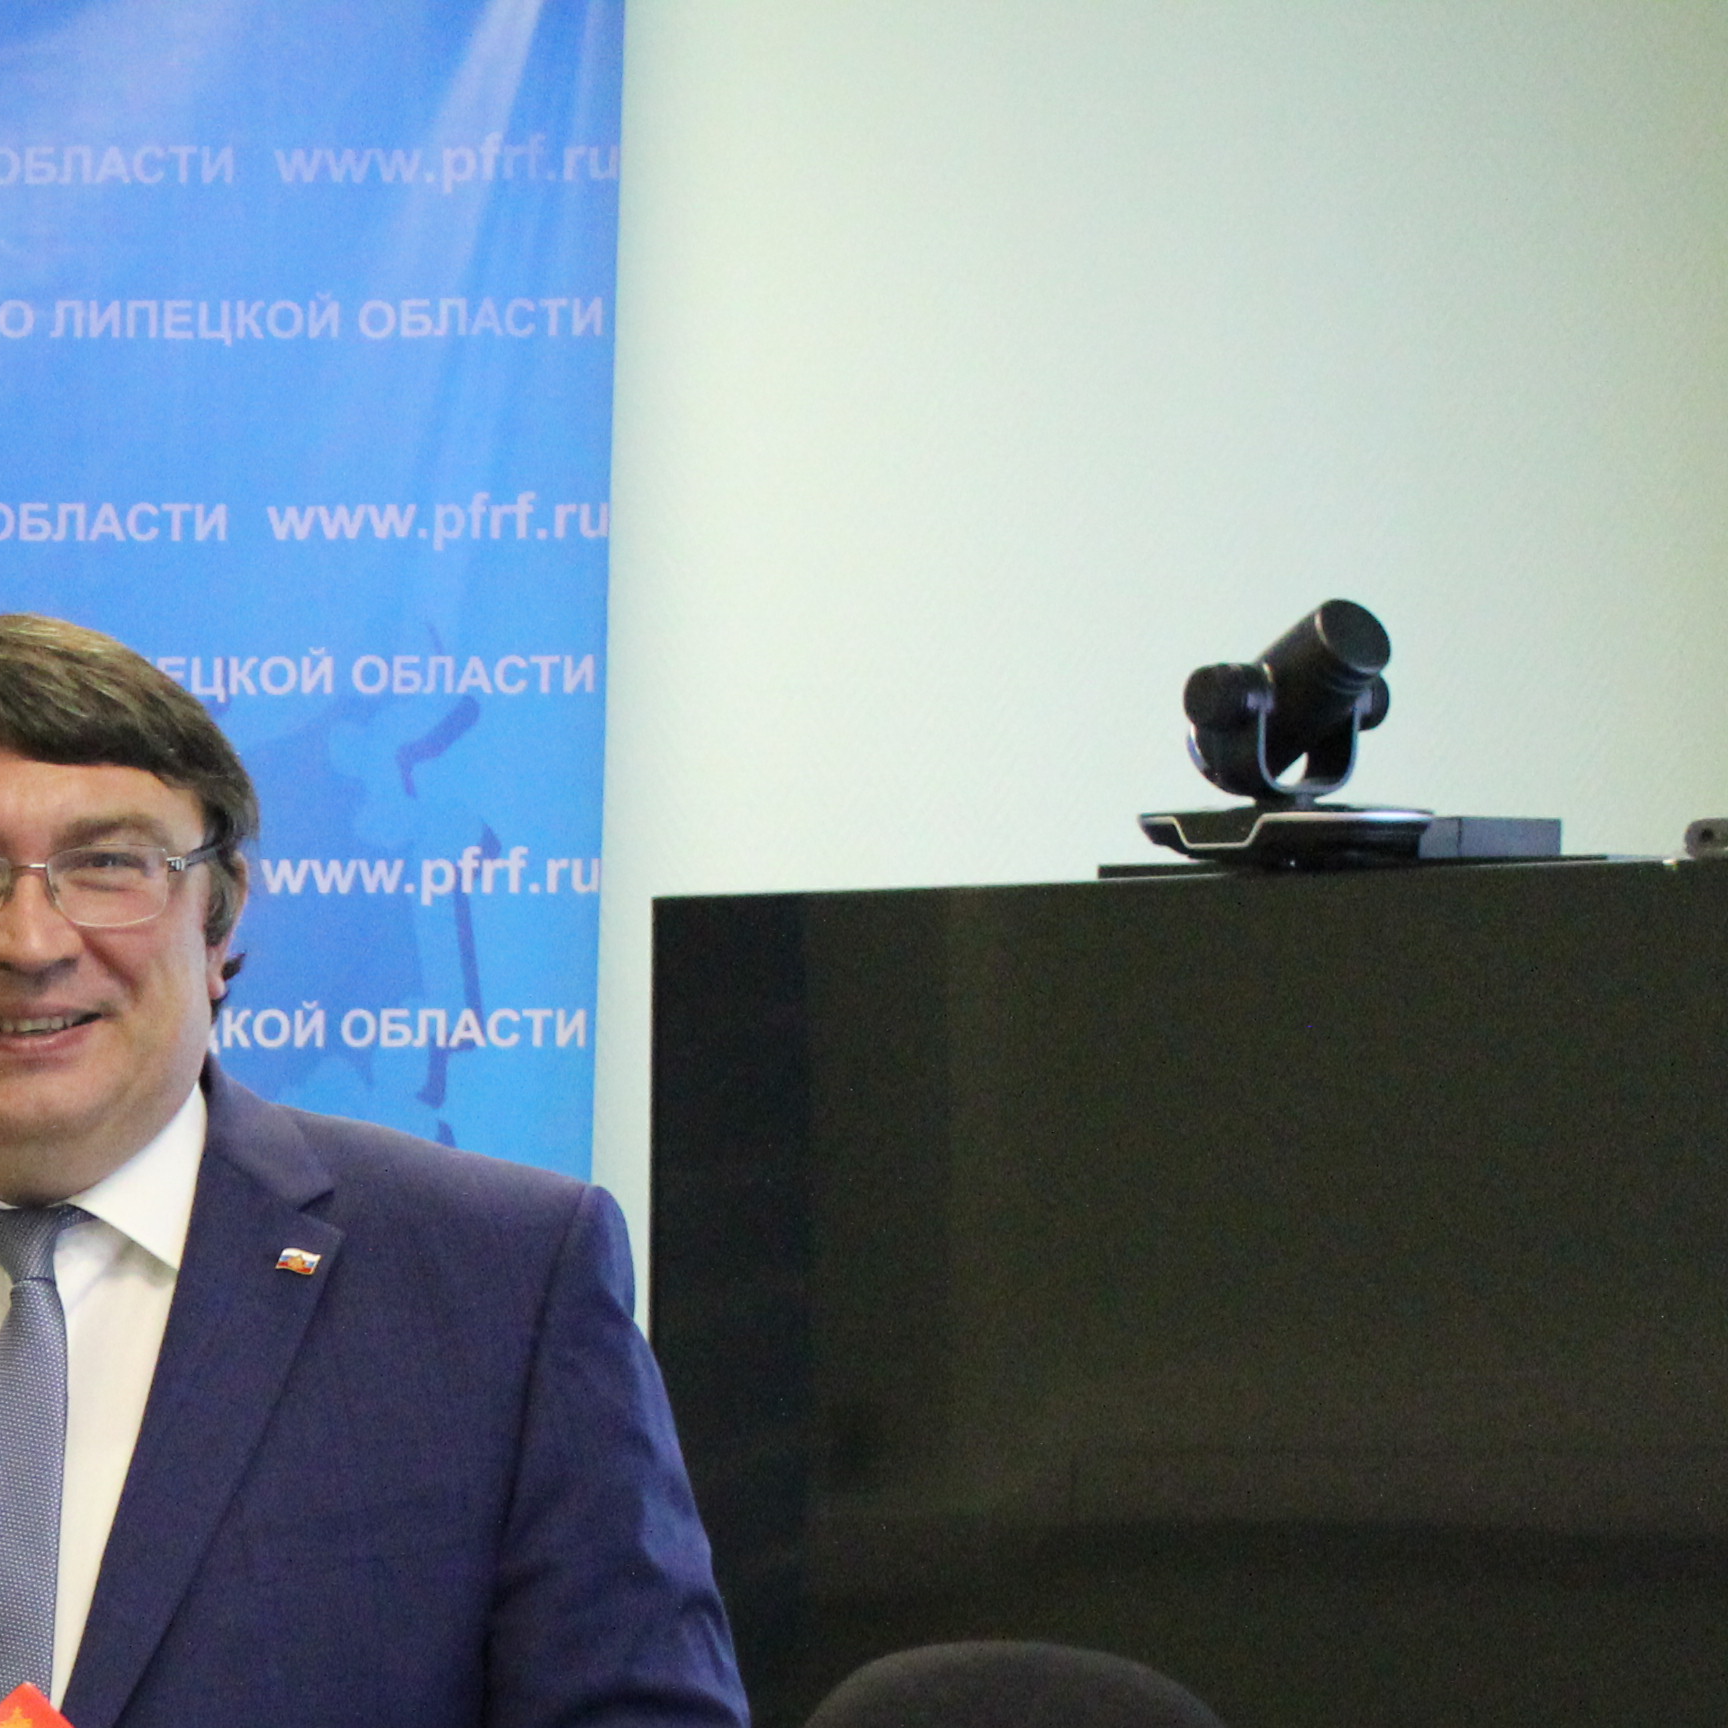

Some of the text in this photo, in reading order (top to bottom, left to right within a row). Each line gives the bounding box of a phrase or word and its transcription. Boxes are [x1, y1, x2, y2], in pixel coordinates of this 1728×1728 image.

[275, 132, 618, 192] www.pfrf.ru
[50, 293, 340, 345] ЛИПЕЦКОЙ
[359, 297, 603, 338] ОБЛАСТИ
[268, 492, 608, 550] www.pfrf.ru
[352, 655, 595, 694] ОБЛАСТИ
[261, 847, 601, 905] www.pfrf.ru
[341, 1009, 586, 1048] ОБЛАСТИ
